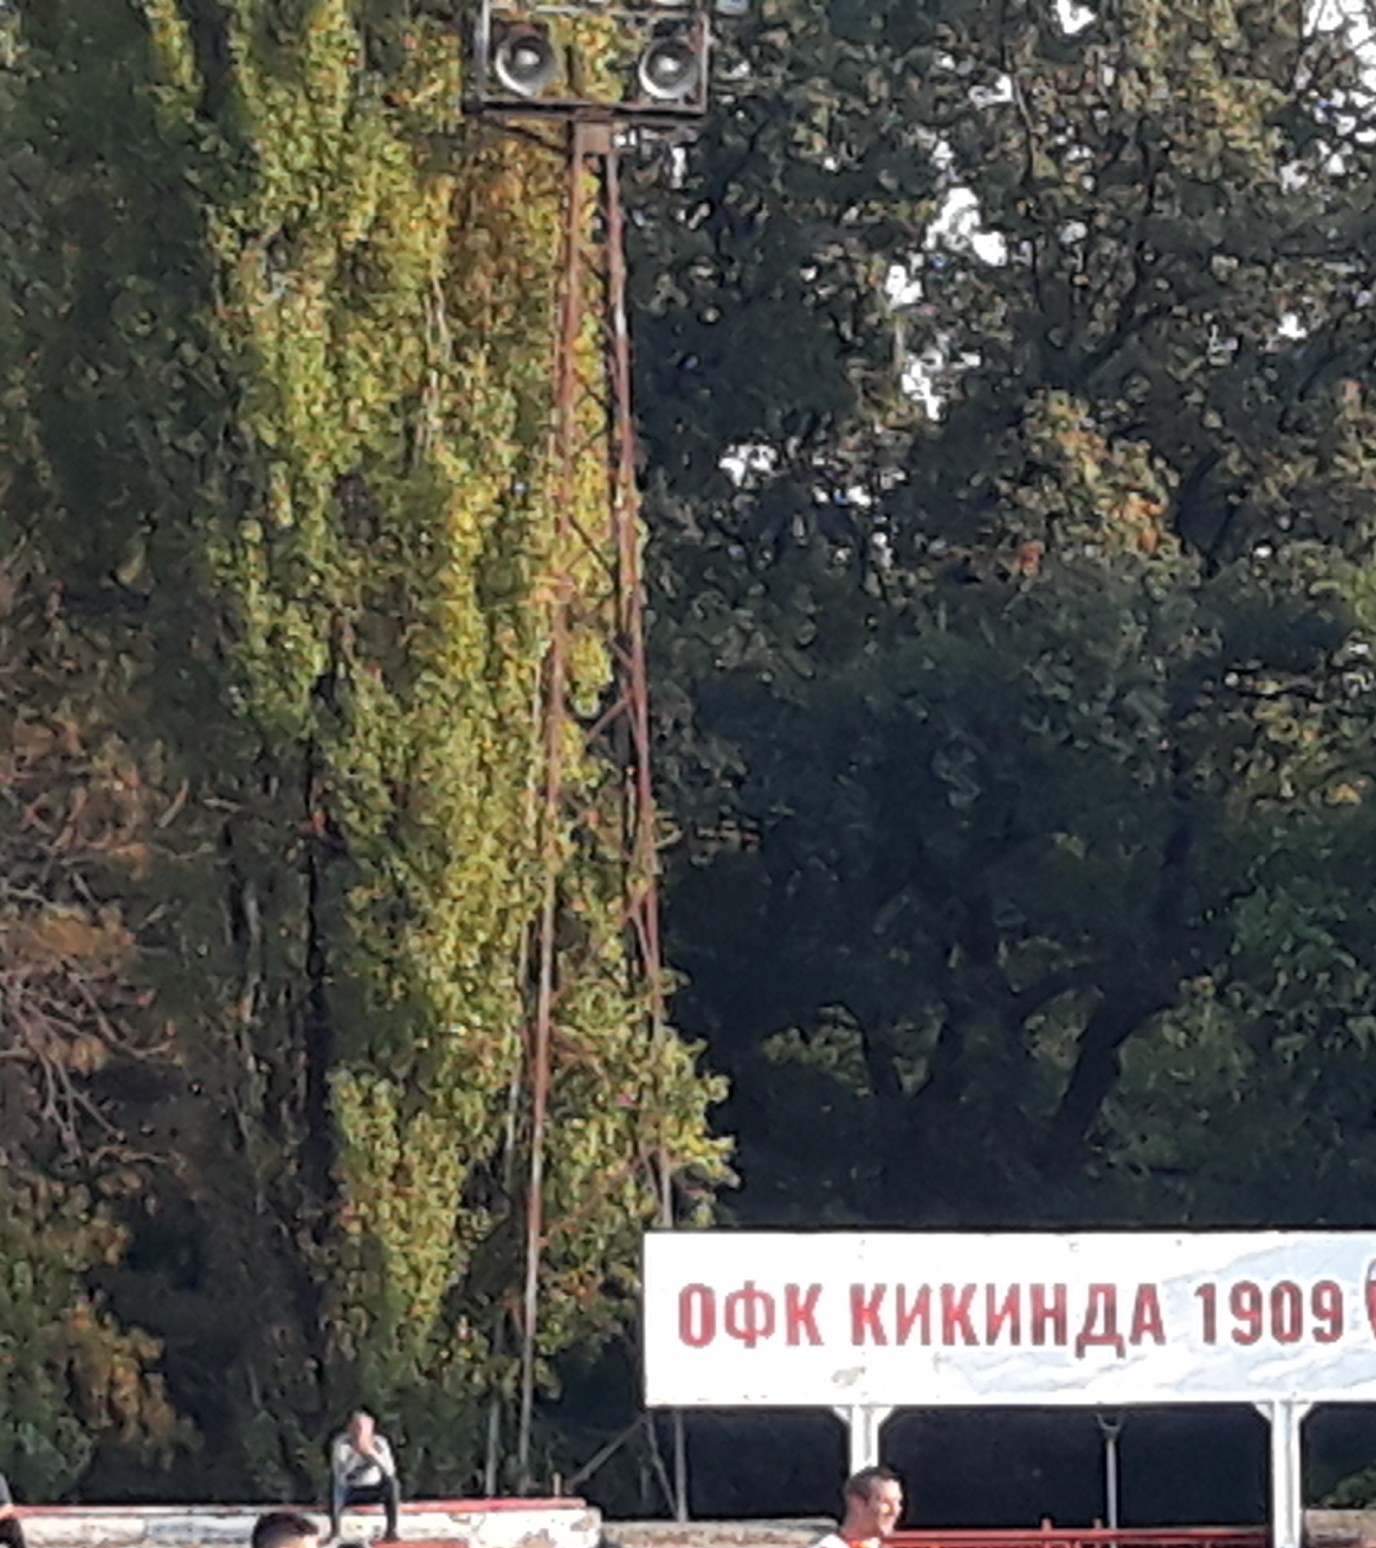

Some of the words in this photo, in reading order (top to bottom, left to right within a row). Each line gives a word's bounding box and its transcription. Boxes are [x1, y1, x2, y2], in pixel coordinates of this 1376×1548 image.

[678, 1280, 824, 1349] ОФК
[850, 1282, 1166, 1360] КИКИНДА
[1194, 1280, 1344, 1346] 1909
